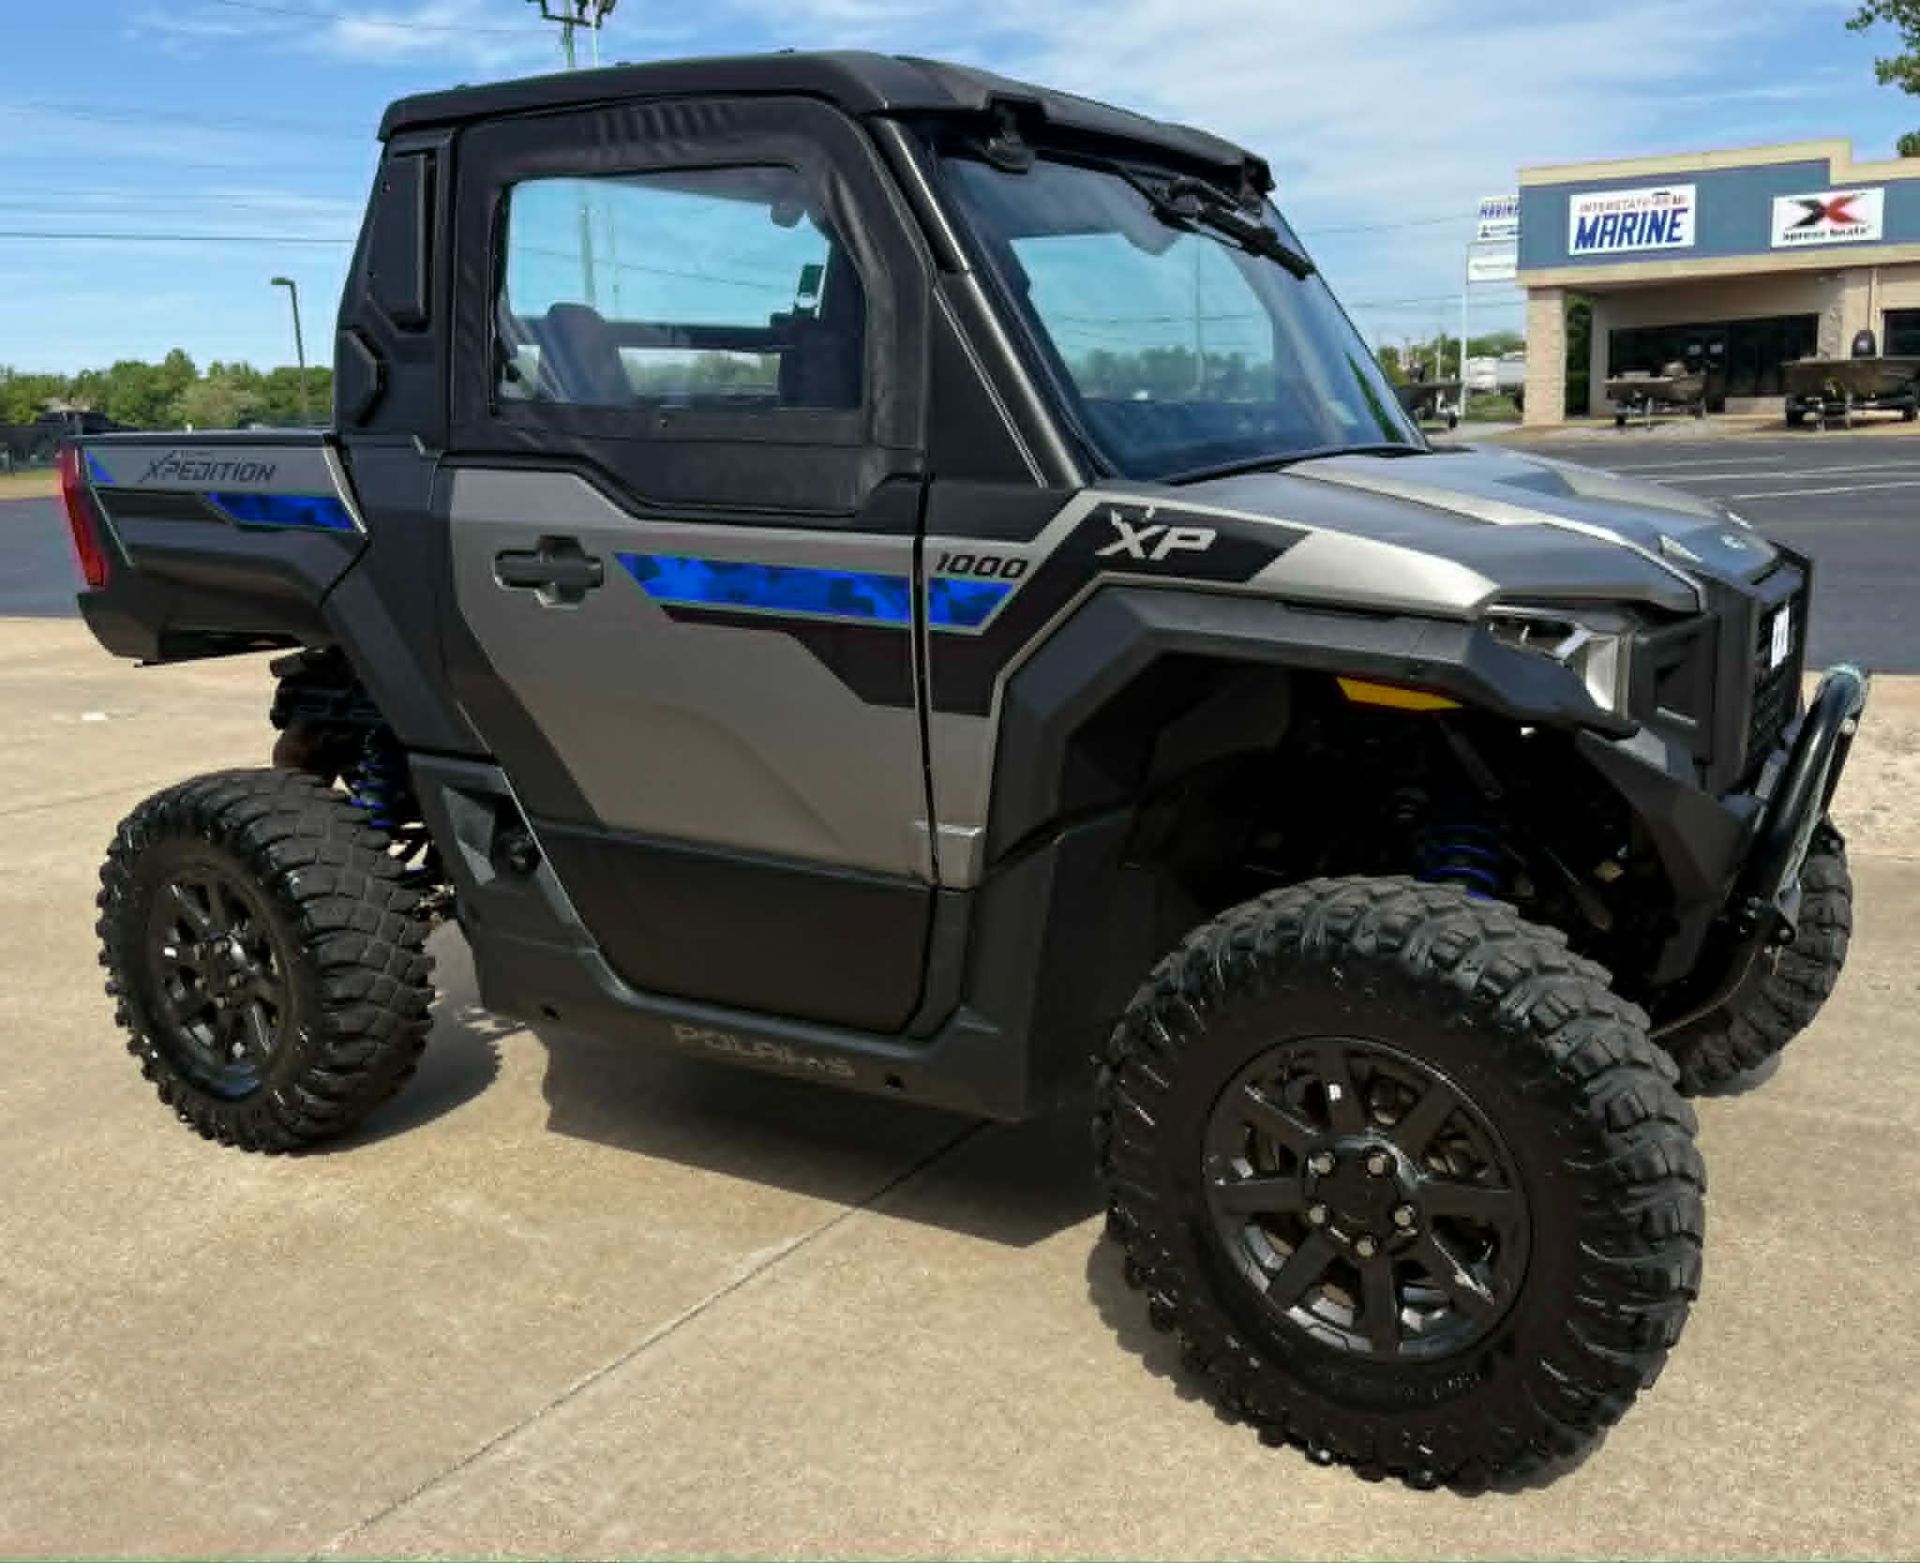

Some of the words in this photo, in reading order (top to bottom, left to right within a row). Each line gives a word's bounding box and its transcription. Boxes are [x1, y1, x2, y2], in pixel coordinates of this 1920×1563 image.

[1574, 207, 1689, 250] MARINE
[138, 454, 276, 482] XPEDITION
[1095, 506, 1217, 561] XP
[935, 553, 1029, 579] 1000
